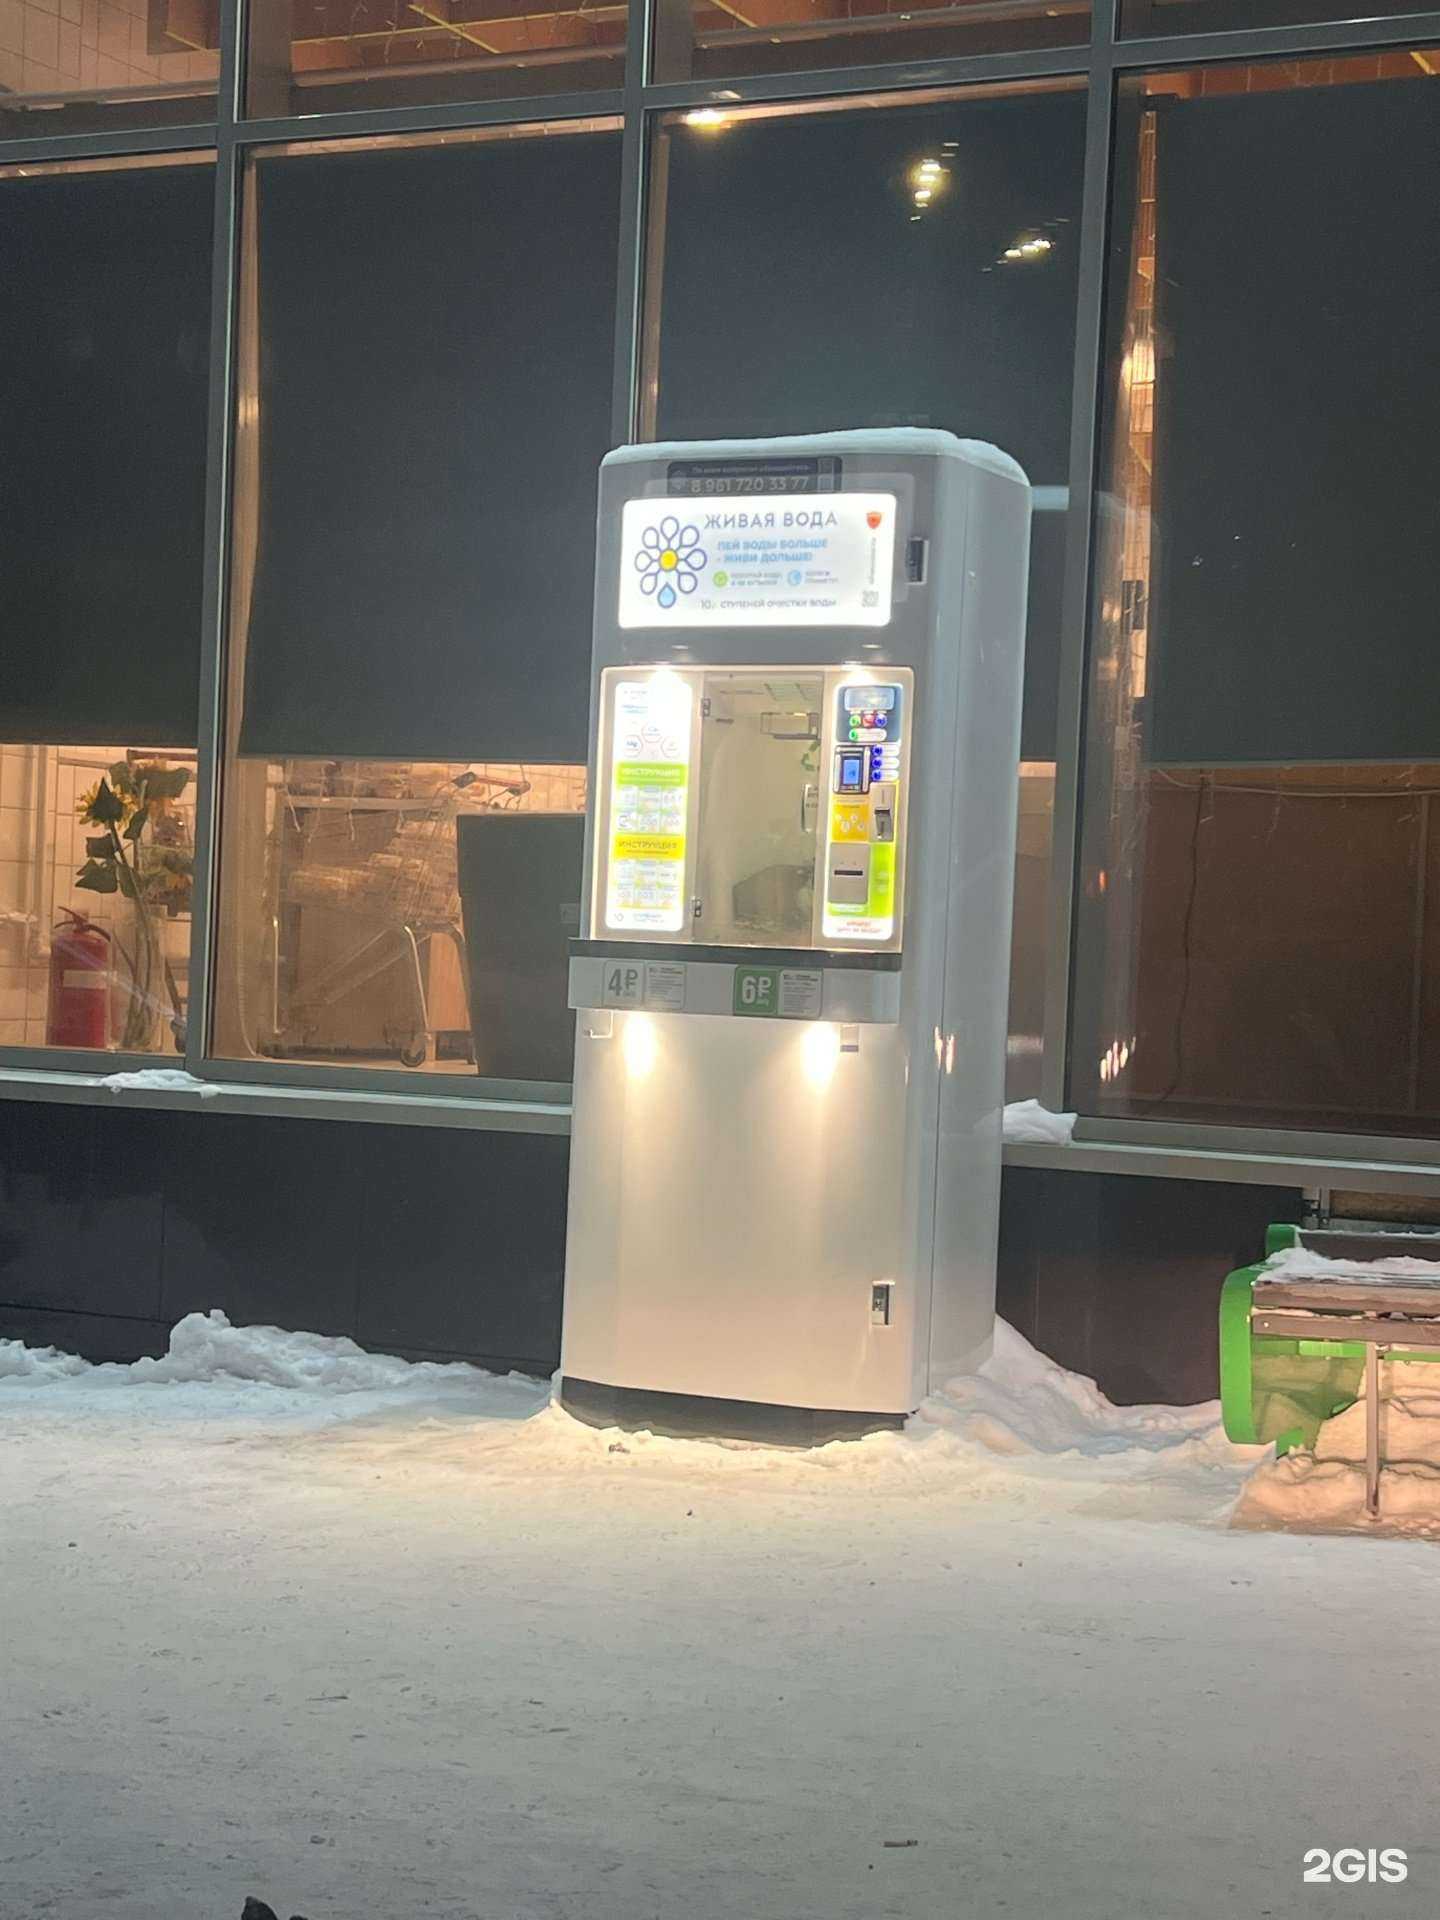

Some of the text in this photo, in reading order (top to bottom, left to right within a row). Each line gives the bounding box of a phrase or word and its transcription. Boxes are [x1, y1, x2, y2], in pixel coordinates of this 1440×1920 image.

[691, 477, 809, 492] 8 961 720 33 77
[704, 511, 838, 529] ЖИВАЯ ВОДА
[718, 538, 828, 551] ПЕЙ ВОДЫ БОЛЬШЕ
[723, 554, 758, 563] ЖИВИ
